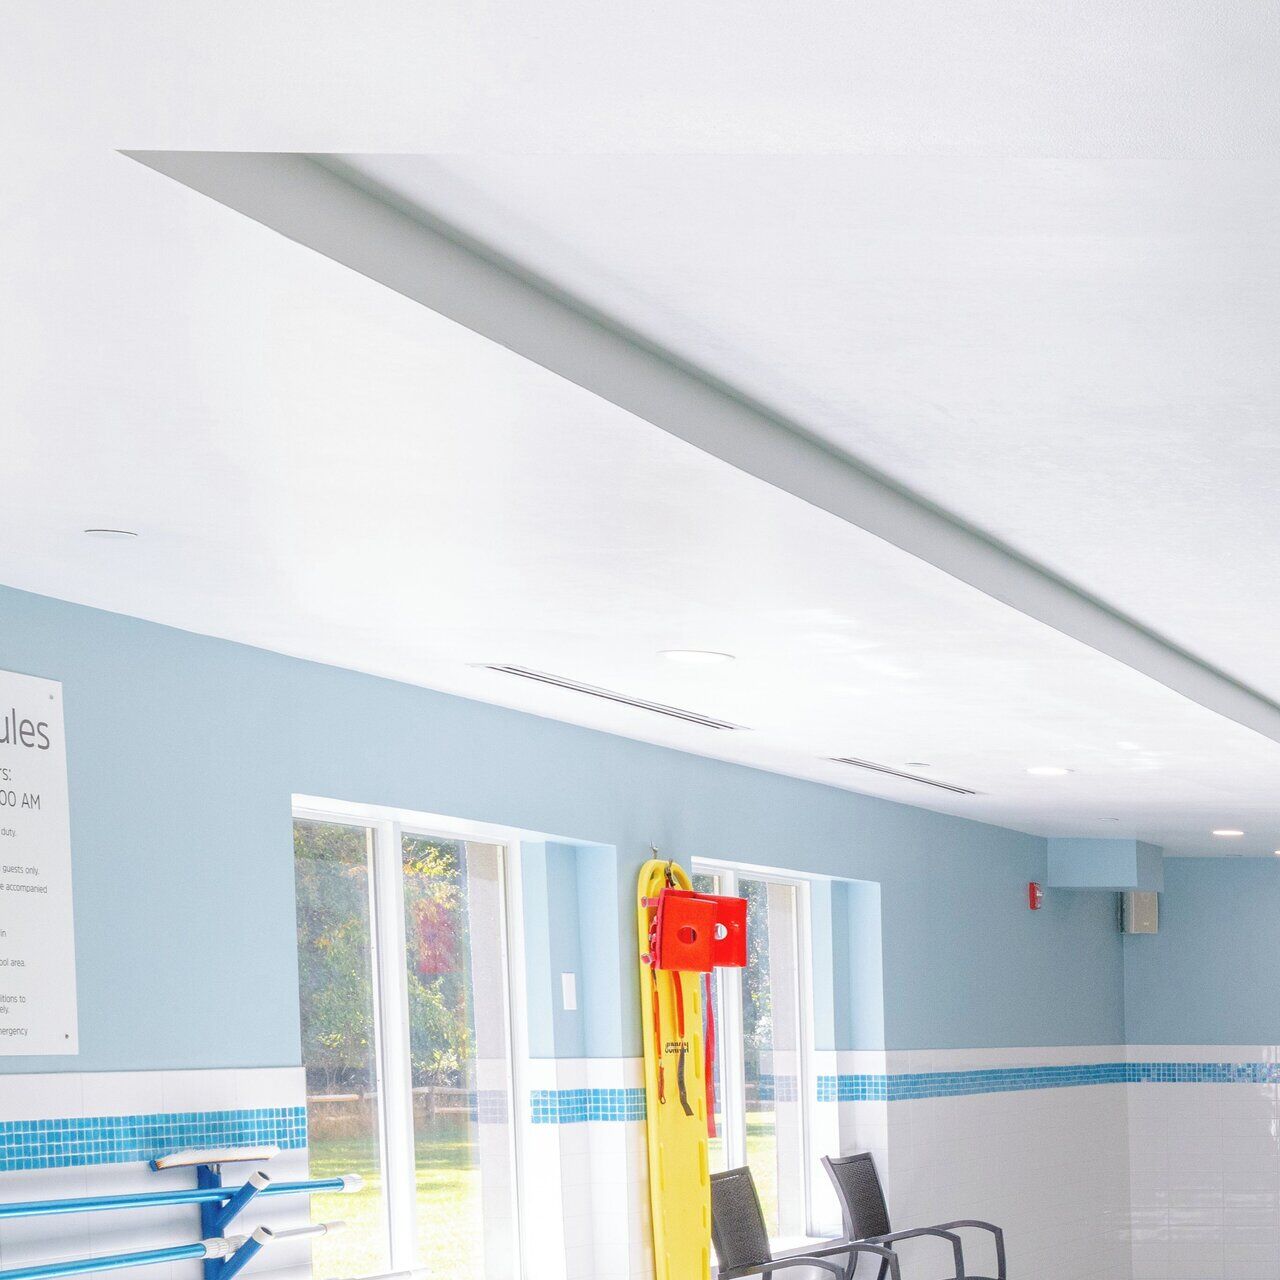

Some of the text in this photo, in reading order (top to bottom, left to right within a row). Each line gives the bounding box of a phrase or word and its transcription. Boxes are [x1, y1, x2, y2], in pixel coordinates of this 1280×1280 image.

[21, 792, 41, 810] AM
[2, 865, 24, 874] guests
[6, 883, 48, 894] accompanied
